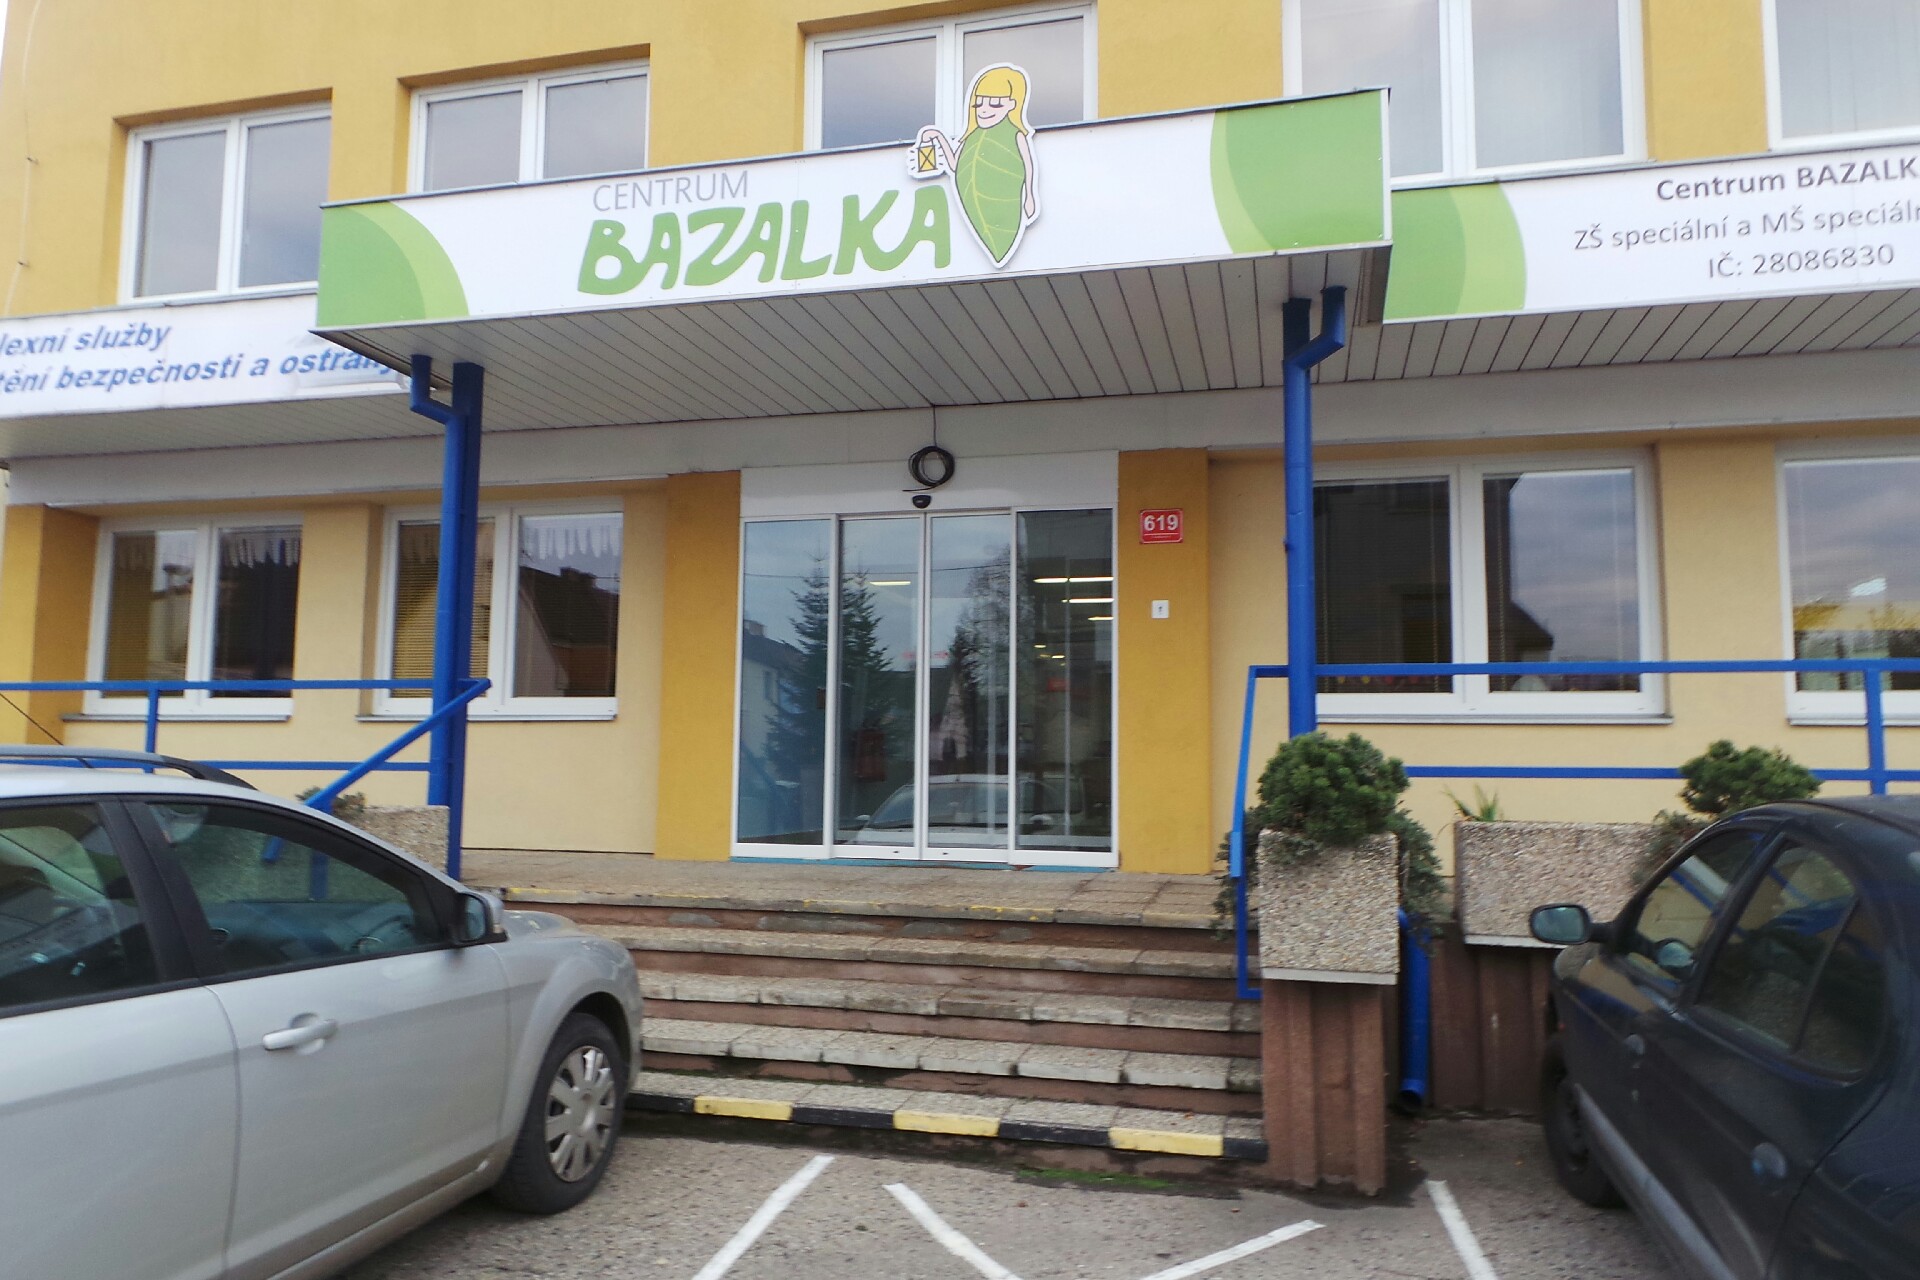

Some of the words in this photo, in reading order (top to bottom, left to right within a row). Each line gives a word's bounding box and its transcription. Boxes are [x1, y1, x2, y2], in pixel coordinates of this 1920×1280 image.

[593, 170, 748, 212] CENTRUM
[1656, 171, 1786, 201] Centrum
[1796, 157, 1919, 188] BAZALK
[577, 184, 952, 296] BAZALKA
[1574, 223, 1603, 250] ZŠ
[1612, 214, 1731, 251] speciální
[1737, 220, 1751, 236] a
[1762, 204, 1805, 234] MŠ
[1709, 252, 1742, 278] IČ:
[1753, 243, 1894, 274] 28086830
[74, 322, 172, 352] služby
[55, 350, 244, 393] bezpečnosti
[249, 357, 270, 377] a
[1144, 514, 1179, 532] 619
